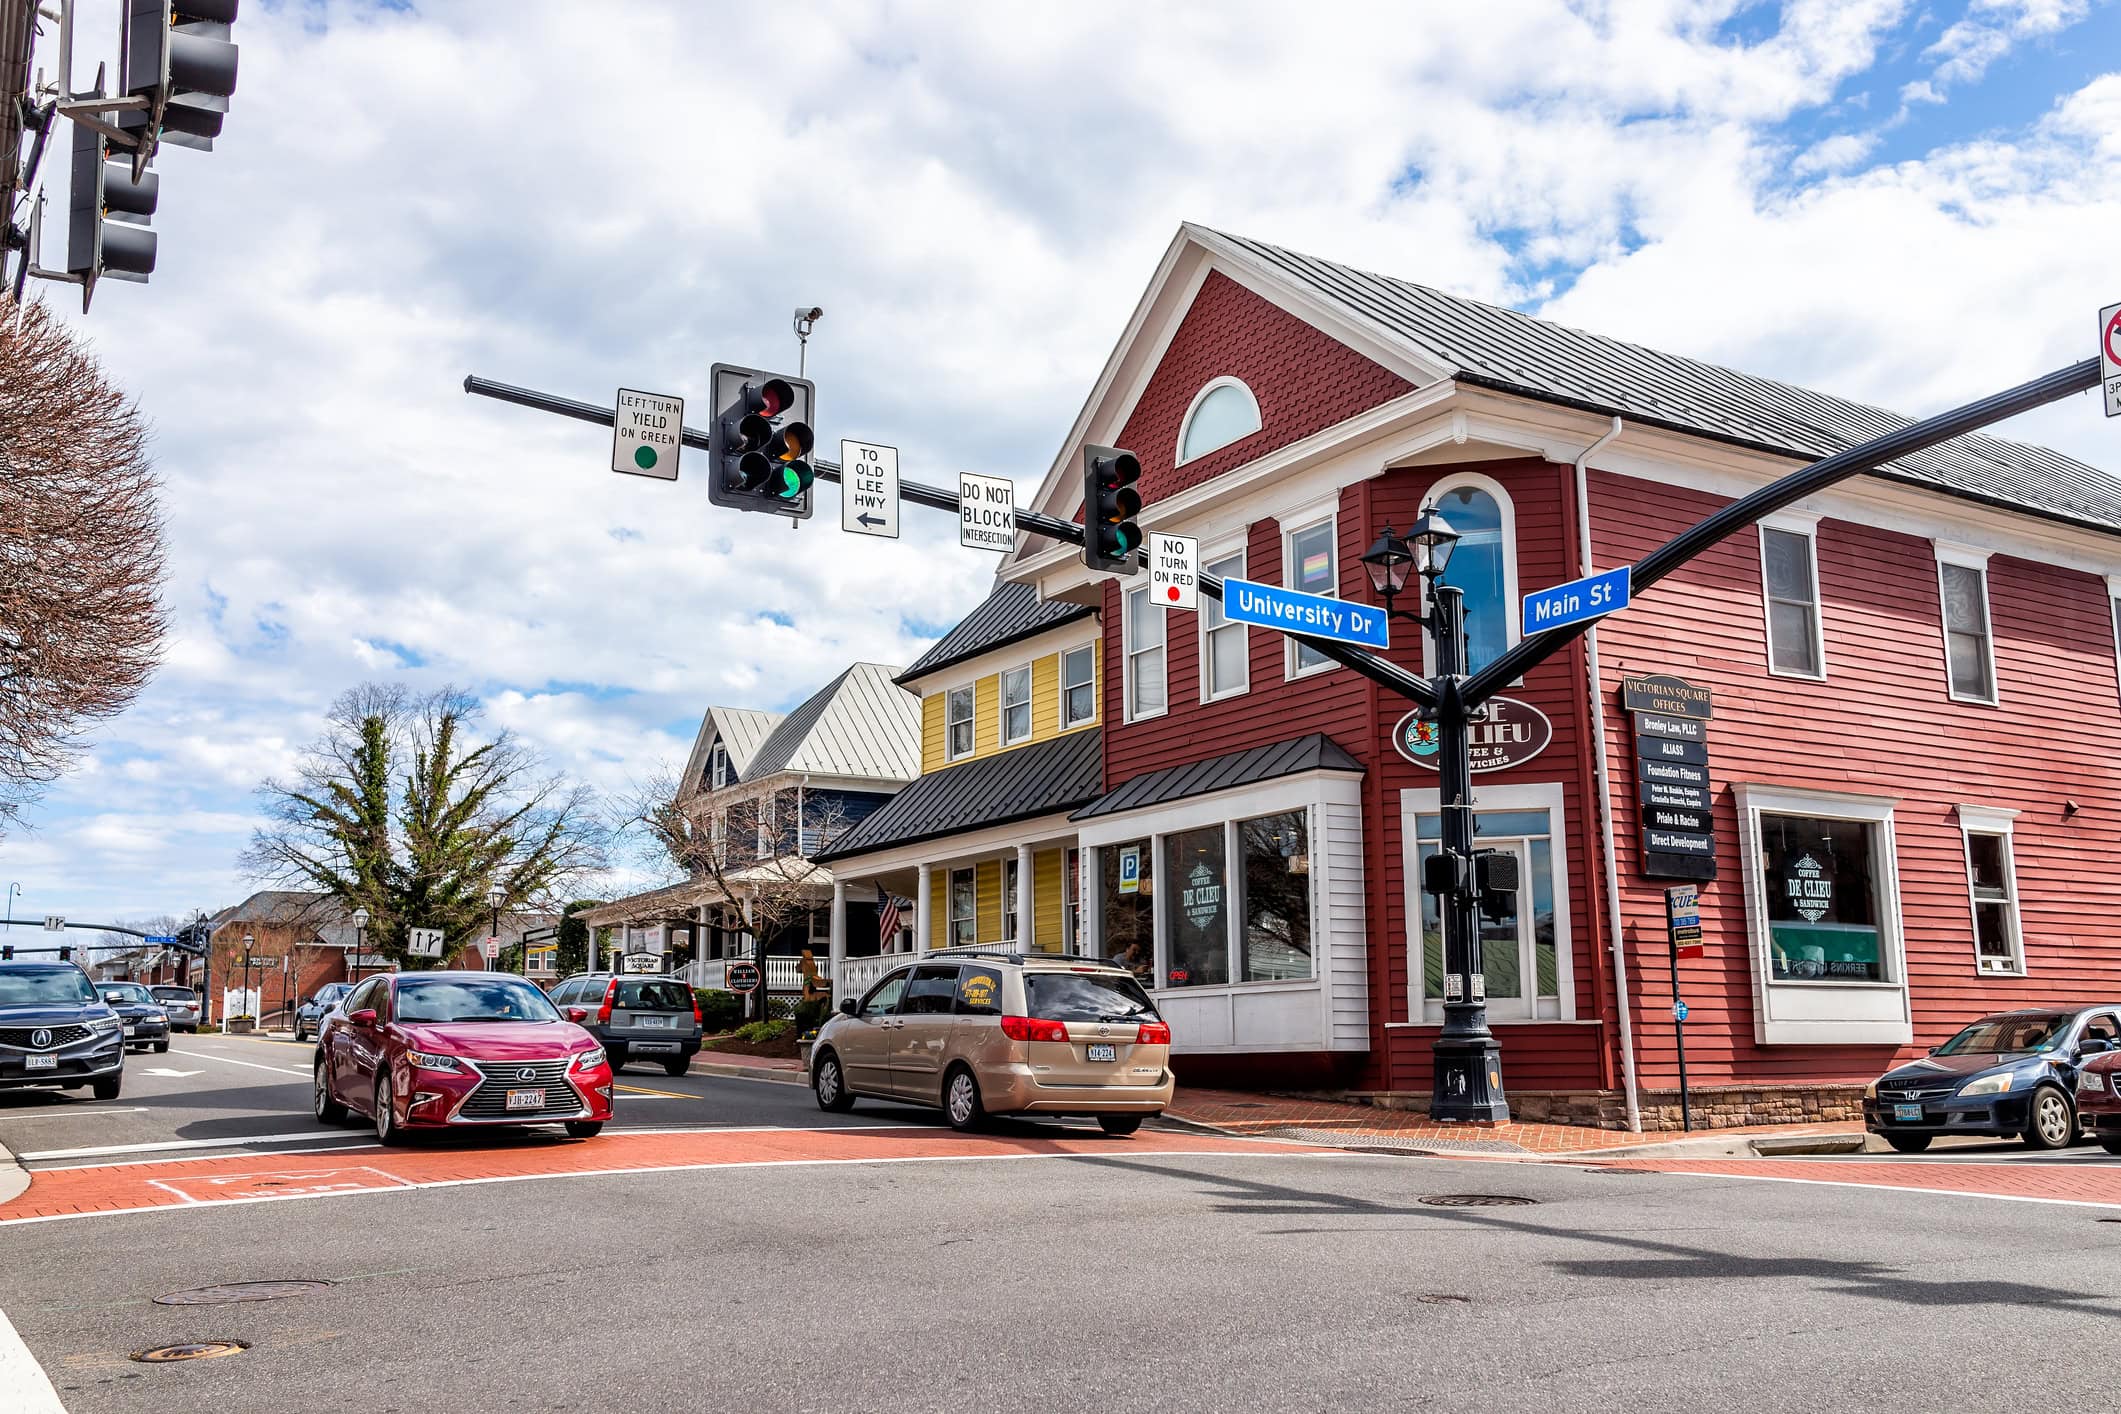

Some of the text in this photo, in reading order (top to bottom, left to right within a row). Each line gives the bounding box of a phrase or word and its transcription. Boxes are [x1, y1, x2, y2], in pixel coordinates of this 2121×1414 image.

[621, 395, 680, 415] LEFT TURN
[633, 411, 667, 429] YIELD
[621, 427, 675, 445] ON GREEN
[860, 448, 878, 461] TO
[856, 463, 884, 478] OLD
[857, 478, 884, 493] LEE
[963, 482, 1011, 505] DO NOT
[855, 493, 886, 509] HWY
[963, 506, 1012, 529] BLOCK
[963, 528, 1013, 546] INTERSECTION
[1164, 540, 1185, 555] NO
[1160, 556, 1188, 570] TURN
[1154, 570, 1194, 586] ON RED
[1535, 581, 1612, 622] Main St
[1239, 589, 1372, 634] University Dr
[1627, 681, 1709, 702] VICTORIAN SQUARE
[1653, 698, 1686, 712] OFFICES
[1467, 722, 1532, 745] LIEU
[1667, 721, 1681, 735] Law,
[1682, 723, 1697, 735] PLLC
[1493, 746, 1504, 756] &
[1647, 764, 1702, 781] Foundation Fitness
[1674, 813, 1679, 825] &
[1680, 814, 1700, 827] Racine
[1651, 833, 1708, 851] Direct Development
[1126, 858, 1135, 877] P
[1798, 868, 1820, 878] COFFEE
[1191, 876, 1211, 887] COFFEE
[1787, 878, 1831, 898] DE CLIEU
[1183, 885, 1220, 906] DE CLIEU
[1673, 894, 1694, 909] CUE
[1799, 899, 1829, 909] SANDWICH
[1169, 970, 1188, 981] OPEN
